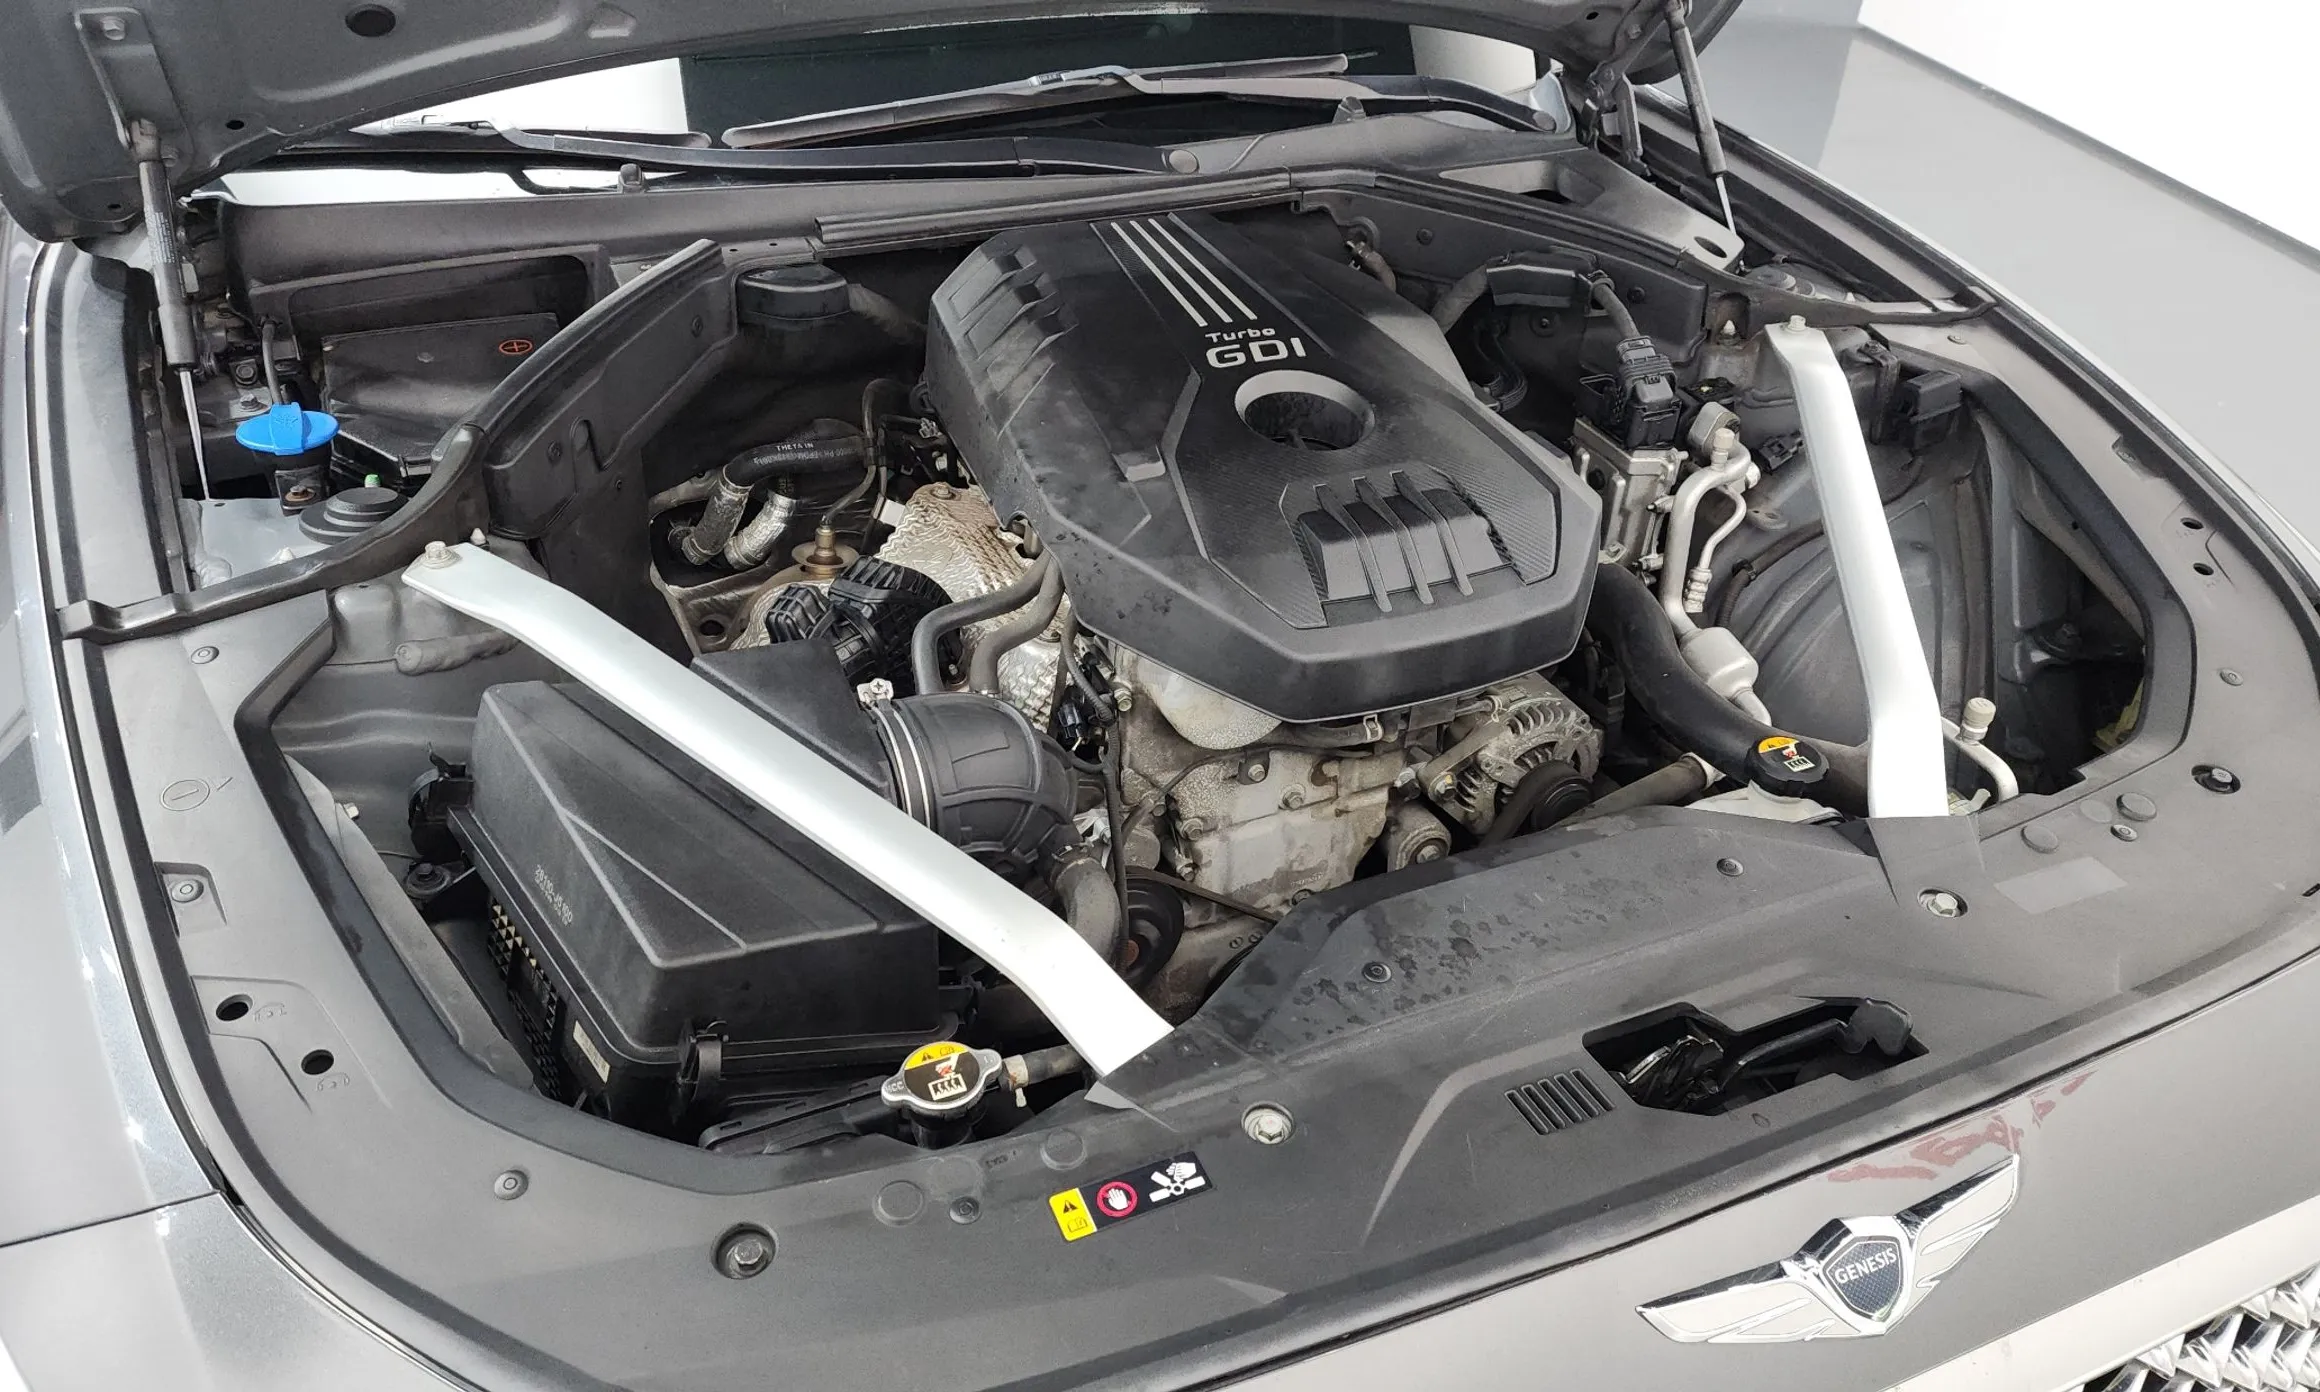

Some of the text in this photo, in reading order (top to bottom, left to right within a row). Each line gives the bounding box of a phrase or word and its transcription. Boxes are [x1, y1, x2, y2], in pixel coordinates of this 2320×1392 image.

[1205, 328, 1276, 343] Turbo
[1206, 337, 1307, 368] GDI
[776, 443, 803, 451] THETA
[1834, 1248, 1897, 1284] GENESIS
